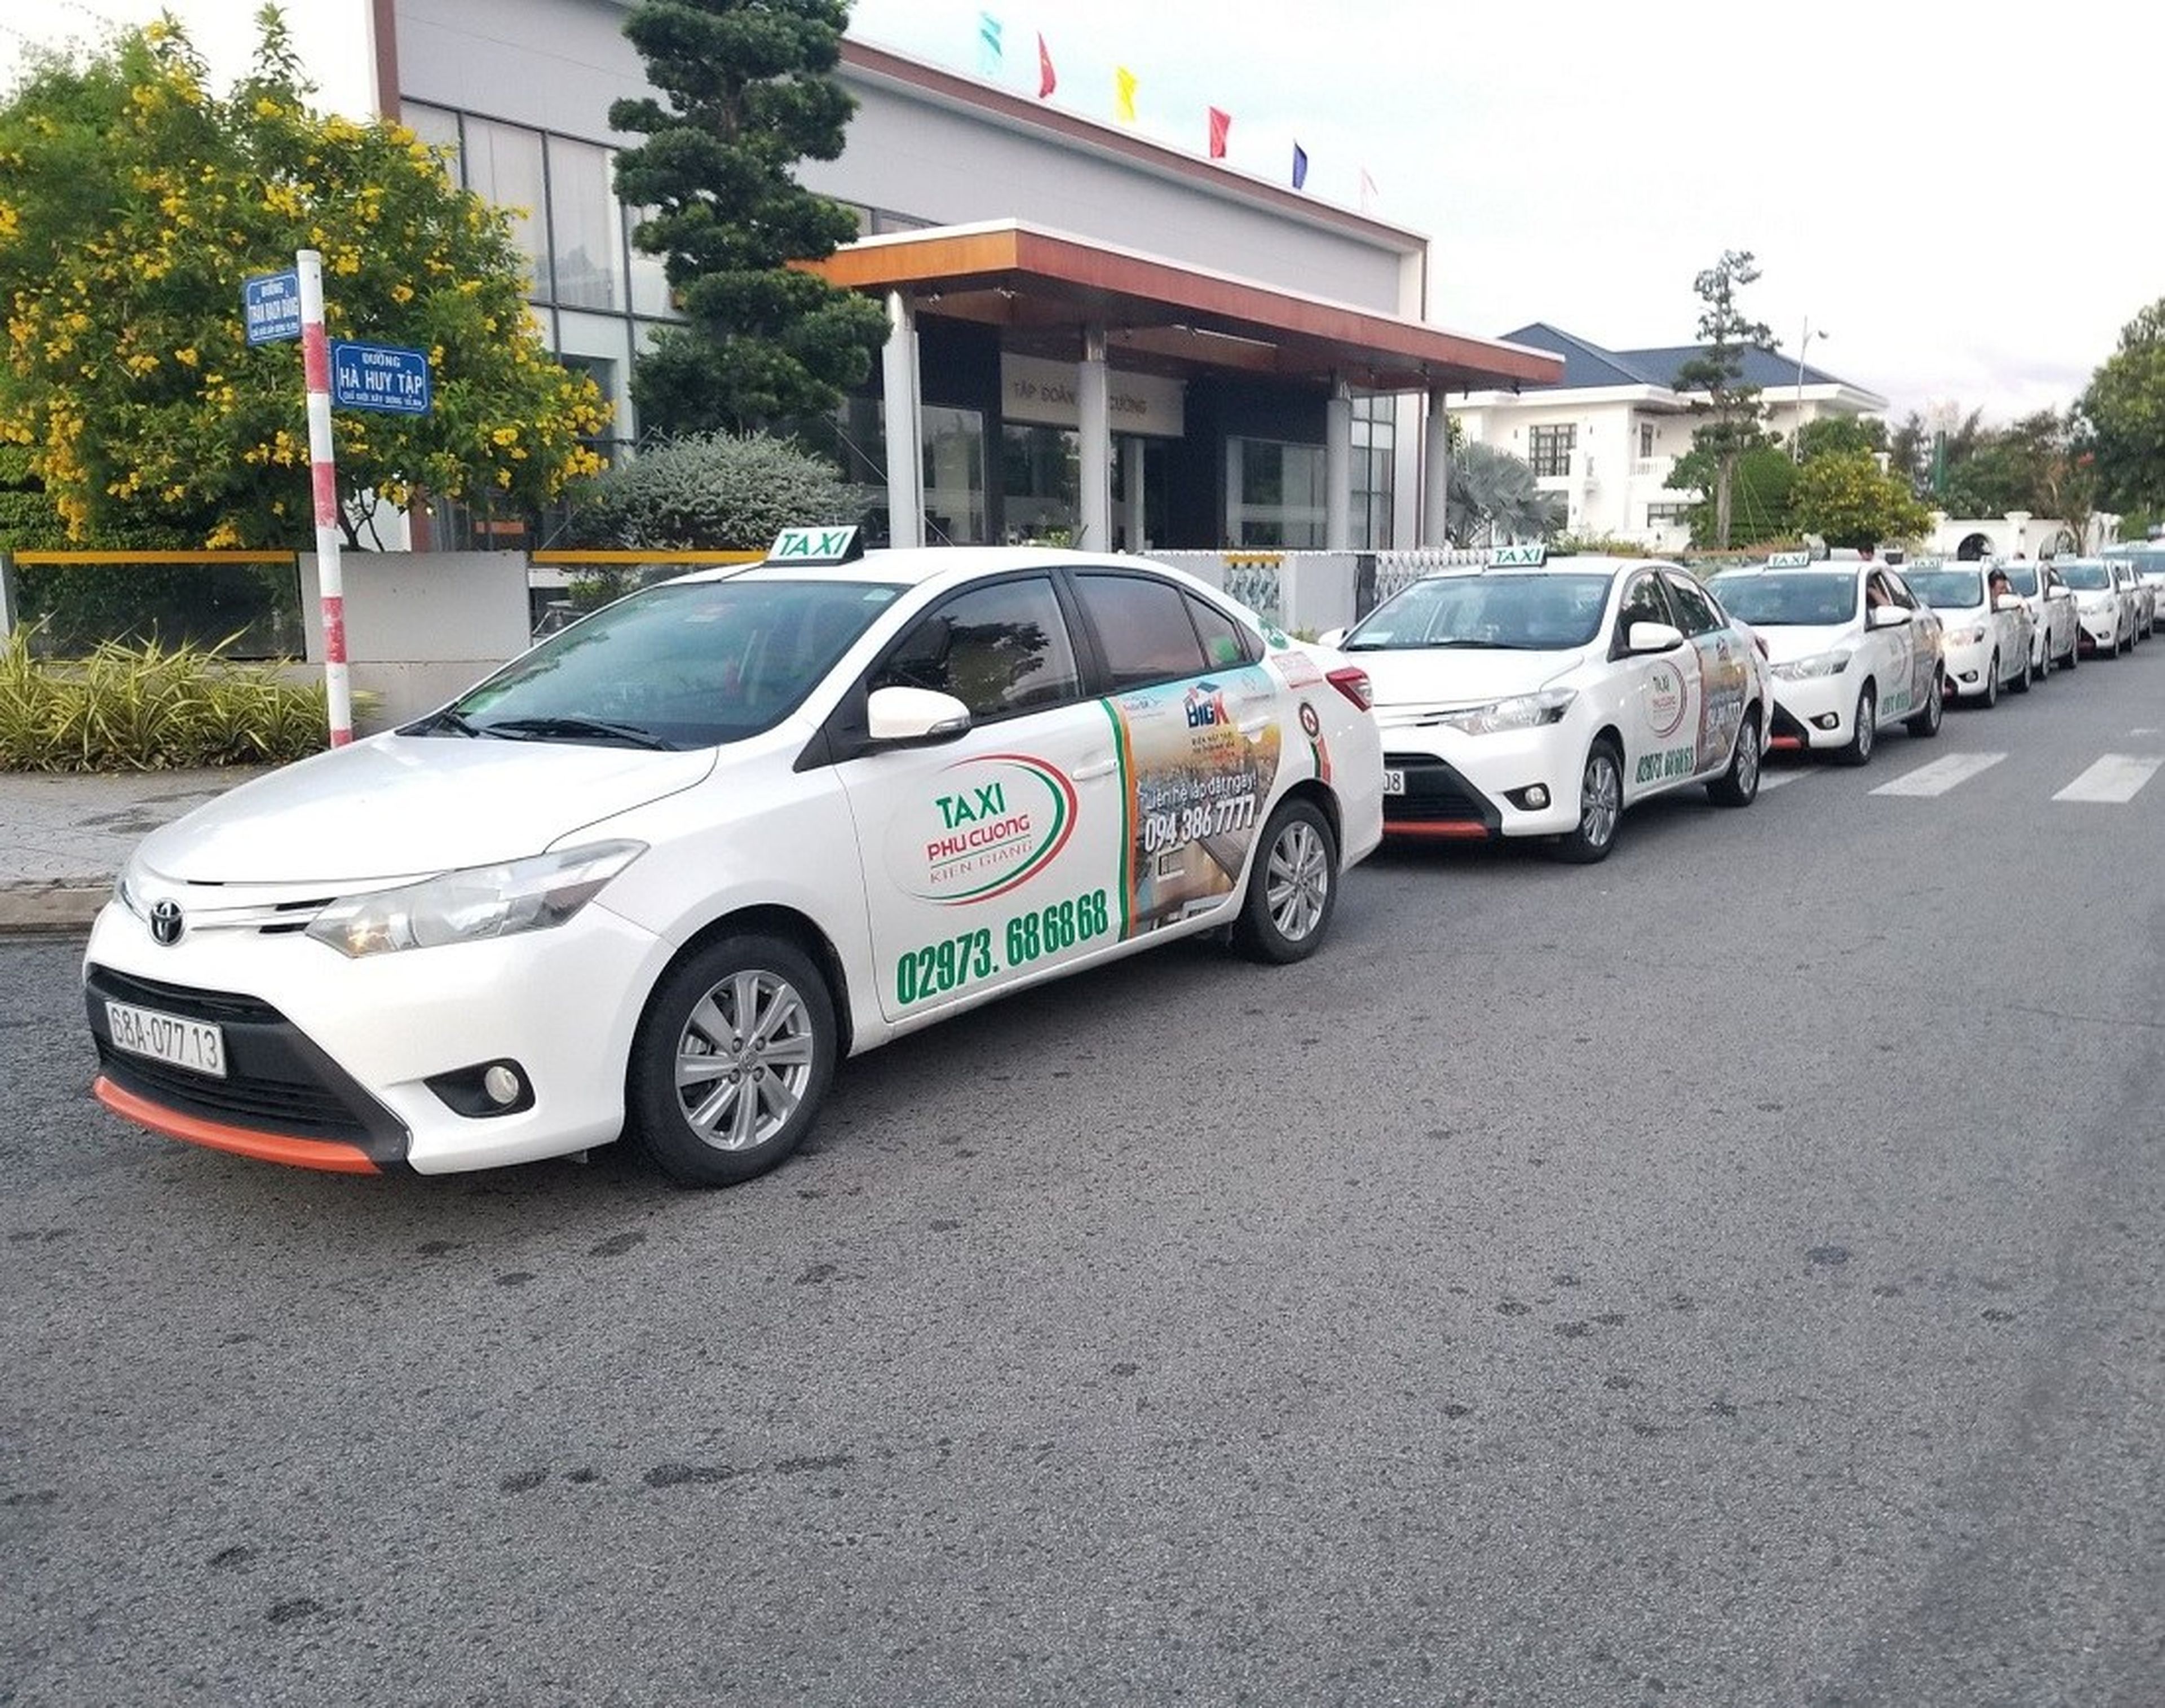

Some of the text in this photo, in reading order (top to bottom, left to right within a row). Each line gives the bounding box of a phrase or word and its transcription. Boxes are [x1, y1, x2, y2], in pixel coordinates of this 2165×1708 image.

[361, 351, 401, 368] ĐƯỜNG
[339, 362, 422, 399] HÀ HUY TẬP
[779, 532, 849, 556] TAXI
[1496, 548, 1540, 563] TAXI
[1773, 555, 1805, 567] TAXI
[935, 782, 1005, 829] TAXI
[1145, 794, 1256, 852] 094 386 7777
[927, 834, 967, 860] PHU
[898, 928, 999, 1005] 02973.
